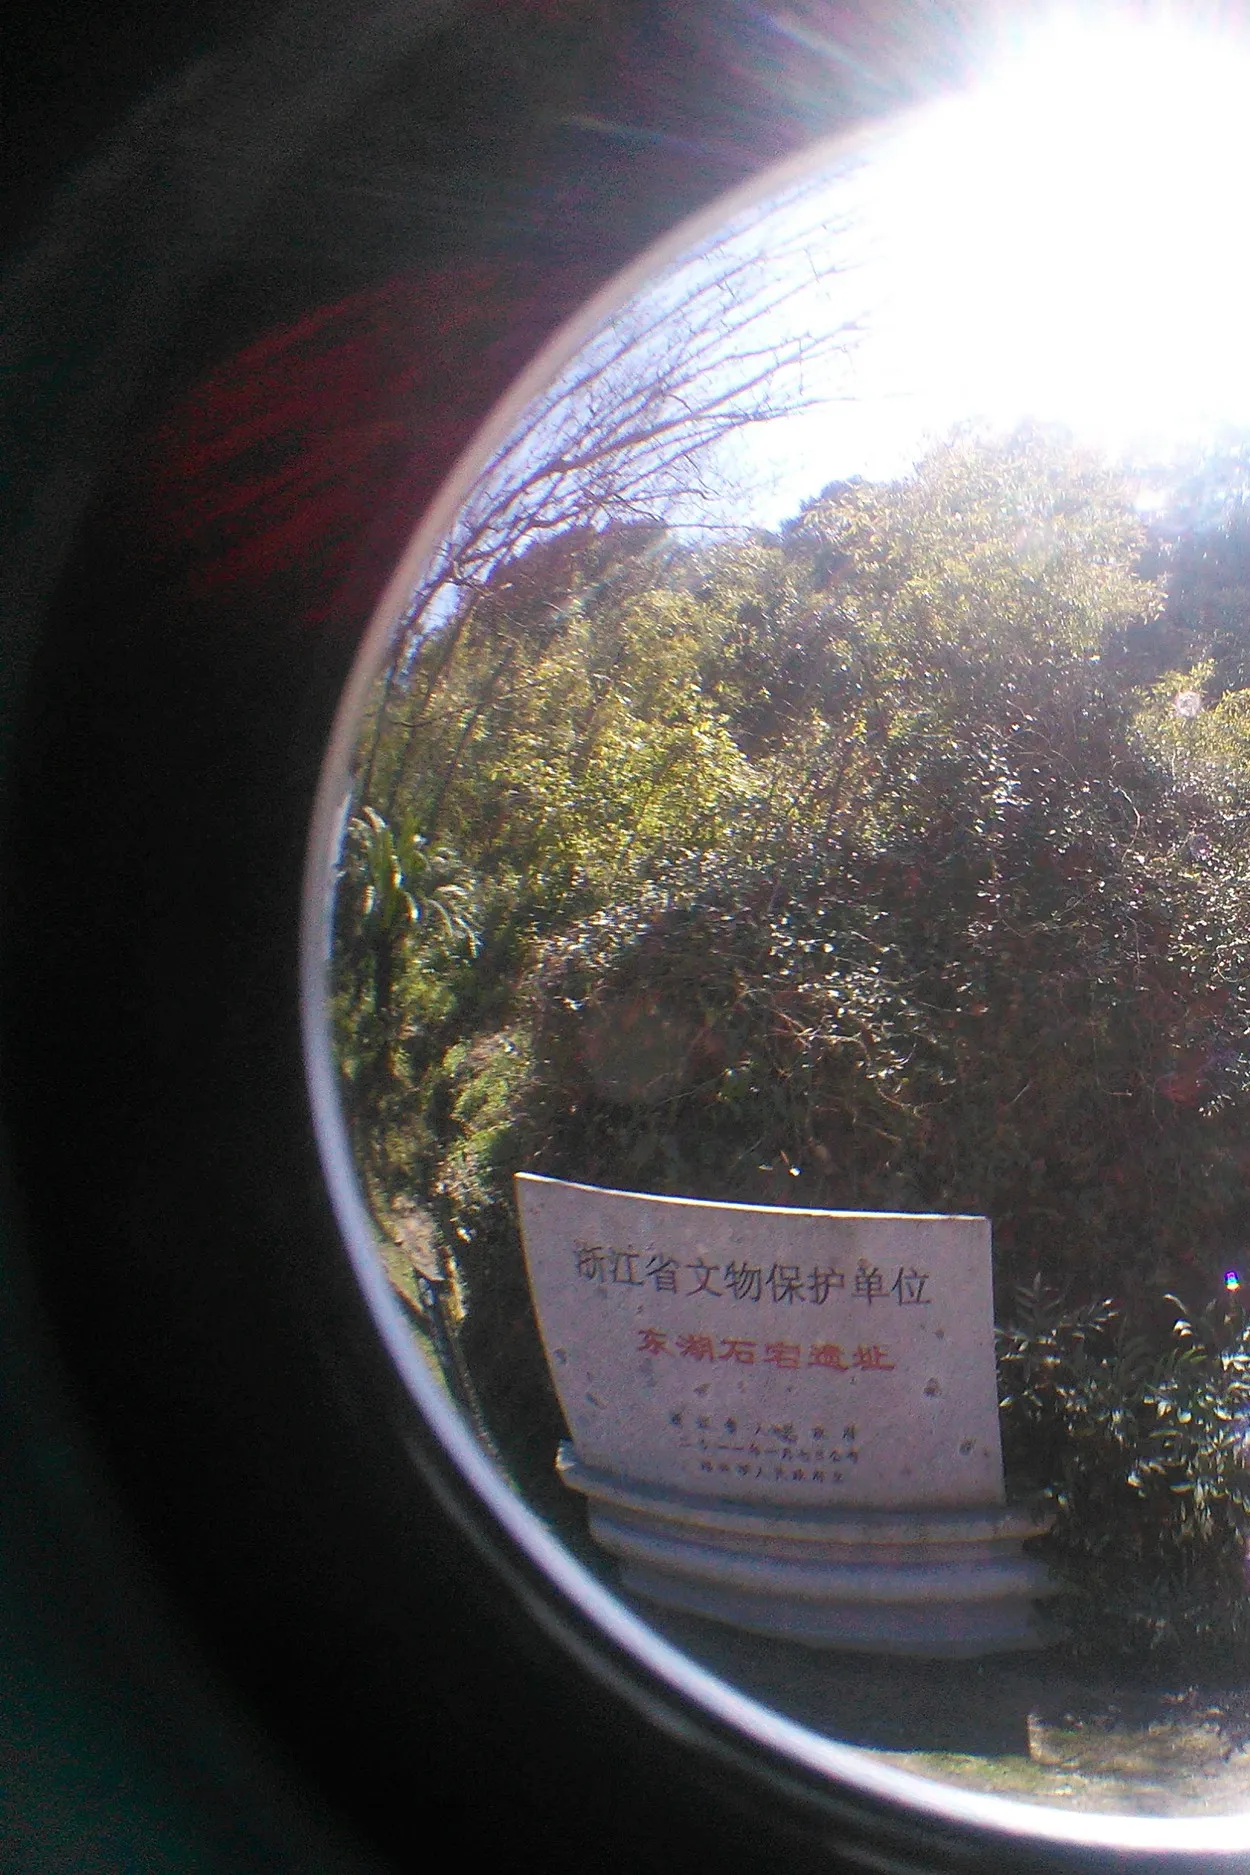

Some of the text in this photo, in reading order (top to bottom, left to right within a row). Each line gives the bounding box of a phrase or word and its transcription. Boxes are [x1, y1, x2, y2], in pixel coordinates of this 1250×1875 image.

[573, 1242, 931, 1305] 浙江省文物保护单位
